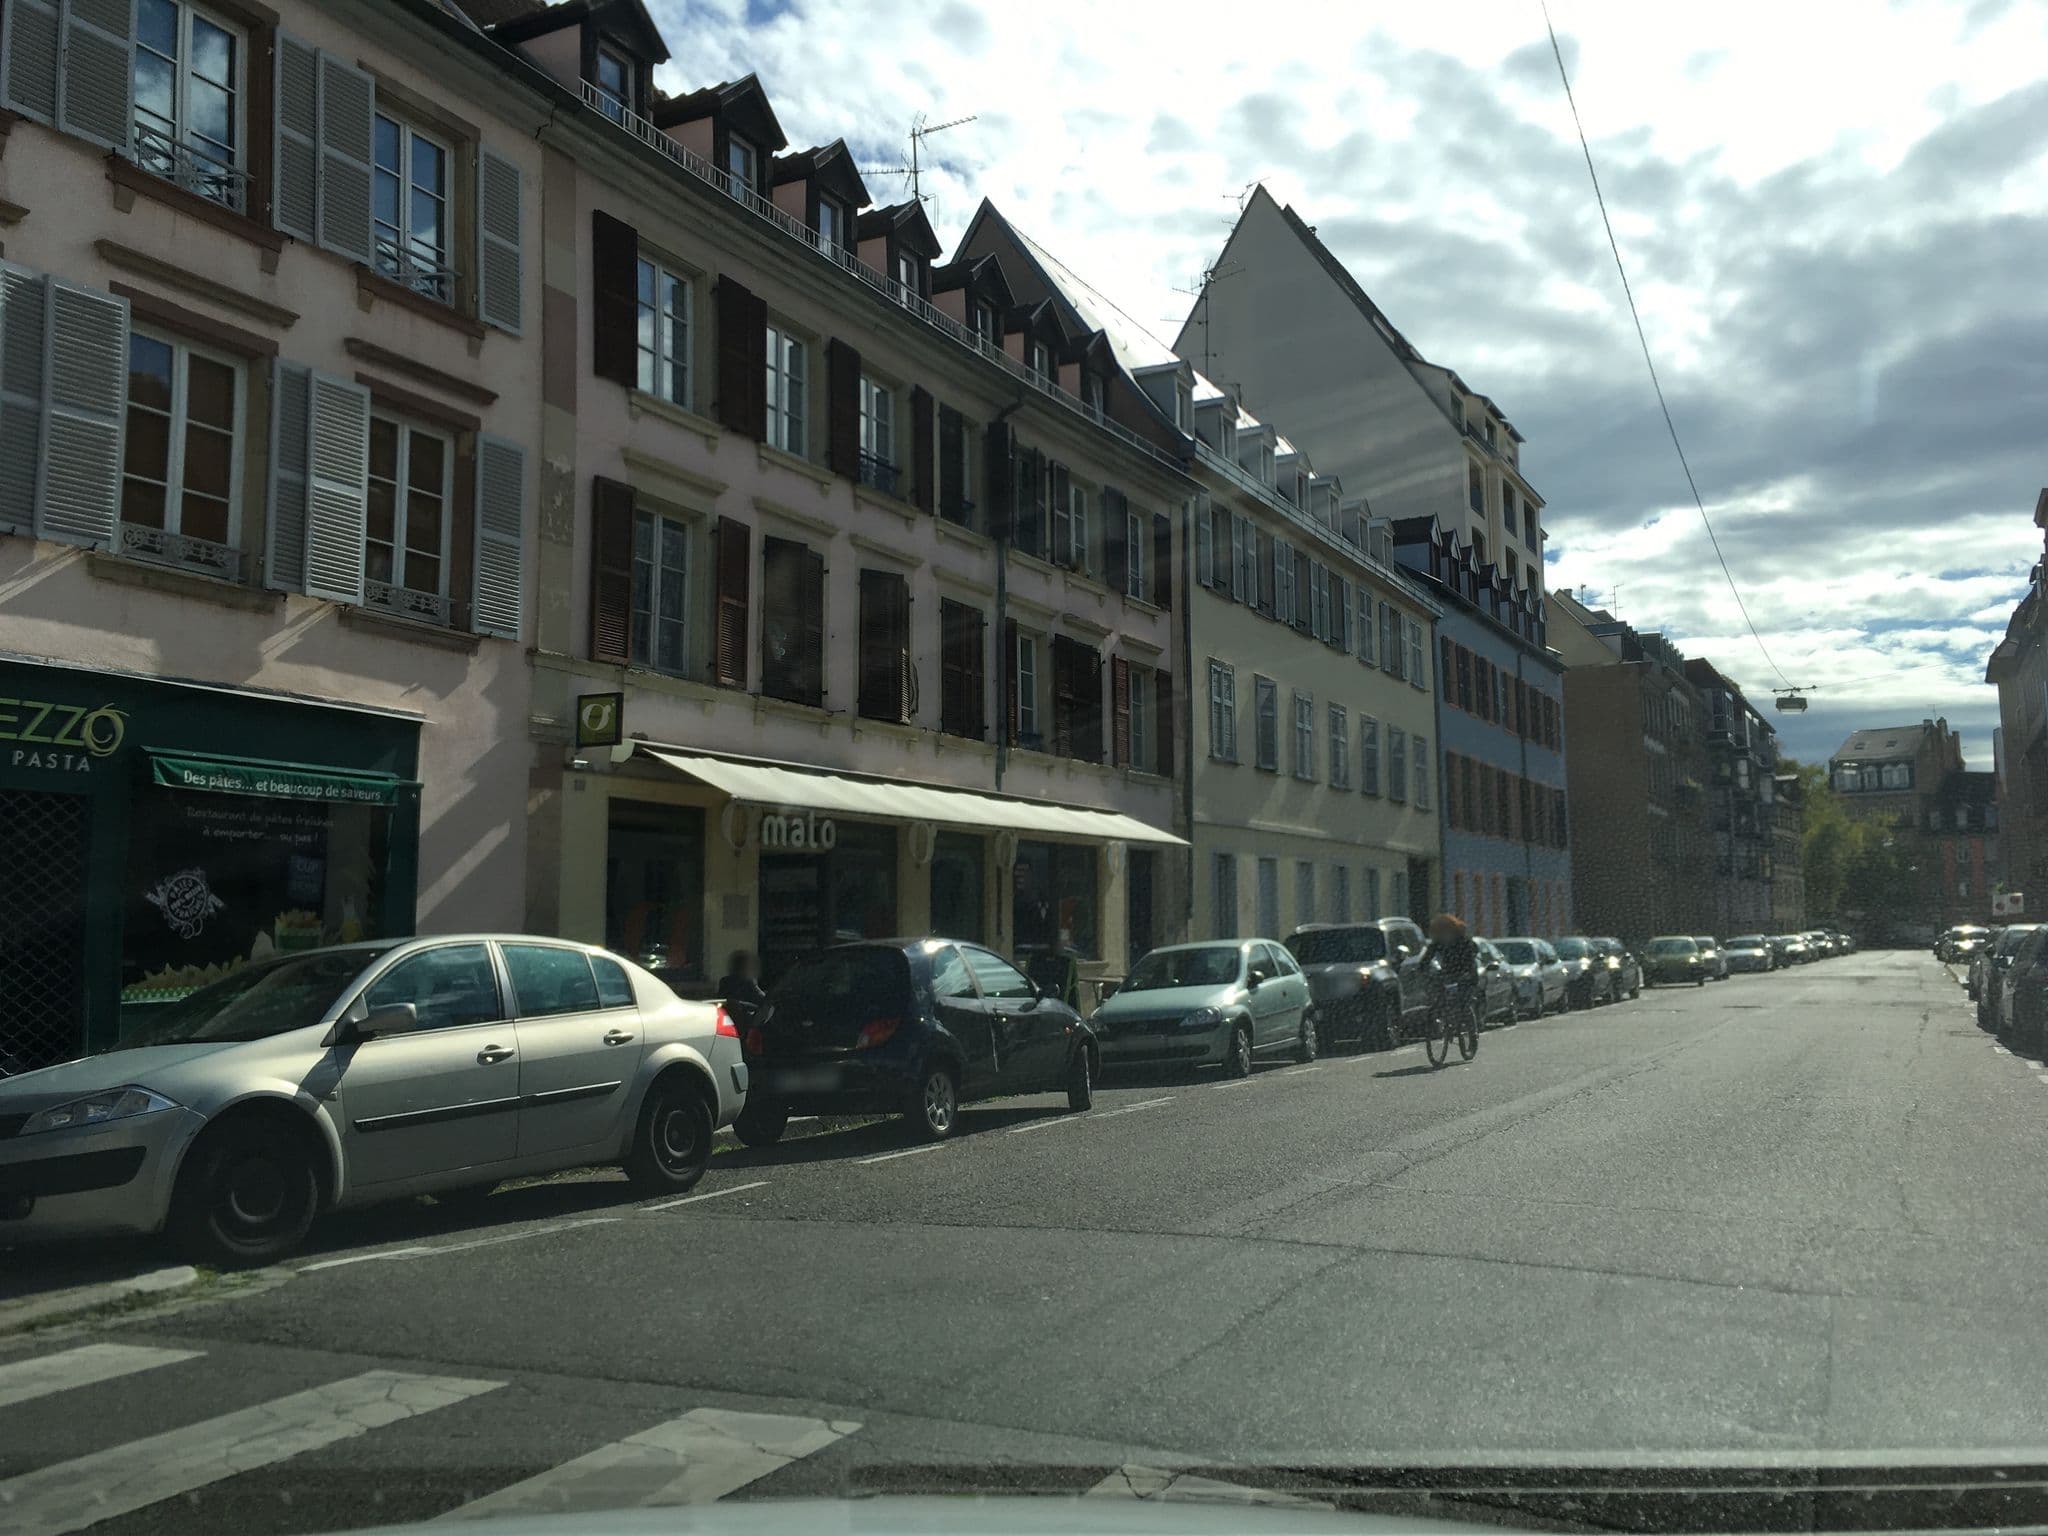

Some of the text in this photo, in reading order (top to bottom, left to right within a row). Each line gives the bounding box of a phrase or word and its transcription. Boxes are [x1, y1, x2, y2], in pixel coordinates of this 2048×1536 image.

[11, 750, 91, 772] PASTA
[184, 770, 381, 800] Des pâtes... et beaucoup de saveurs
